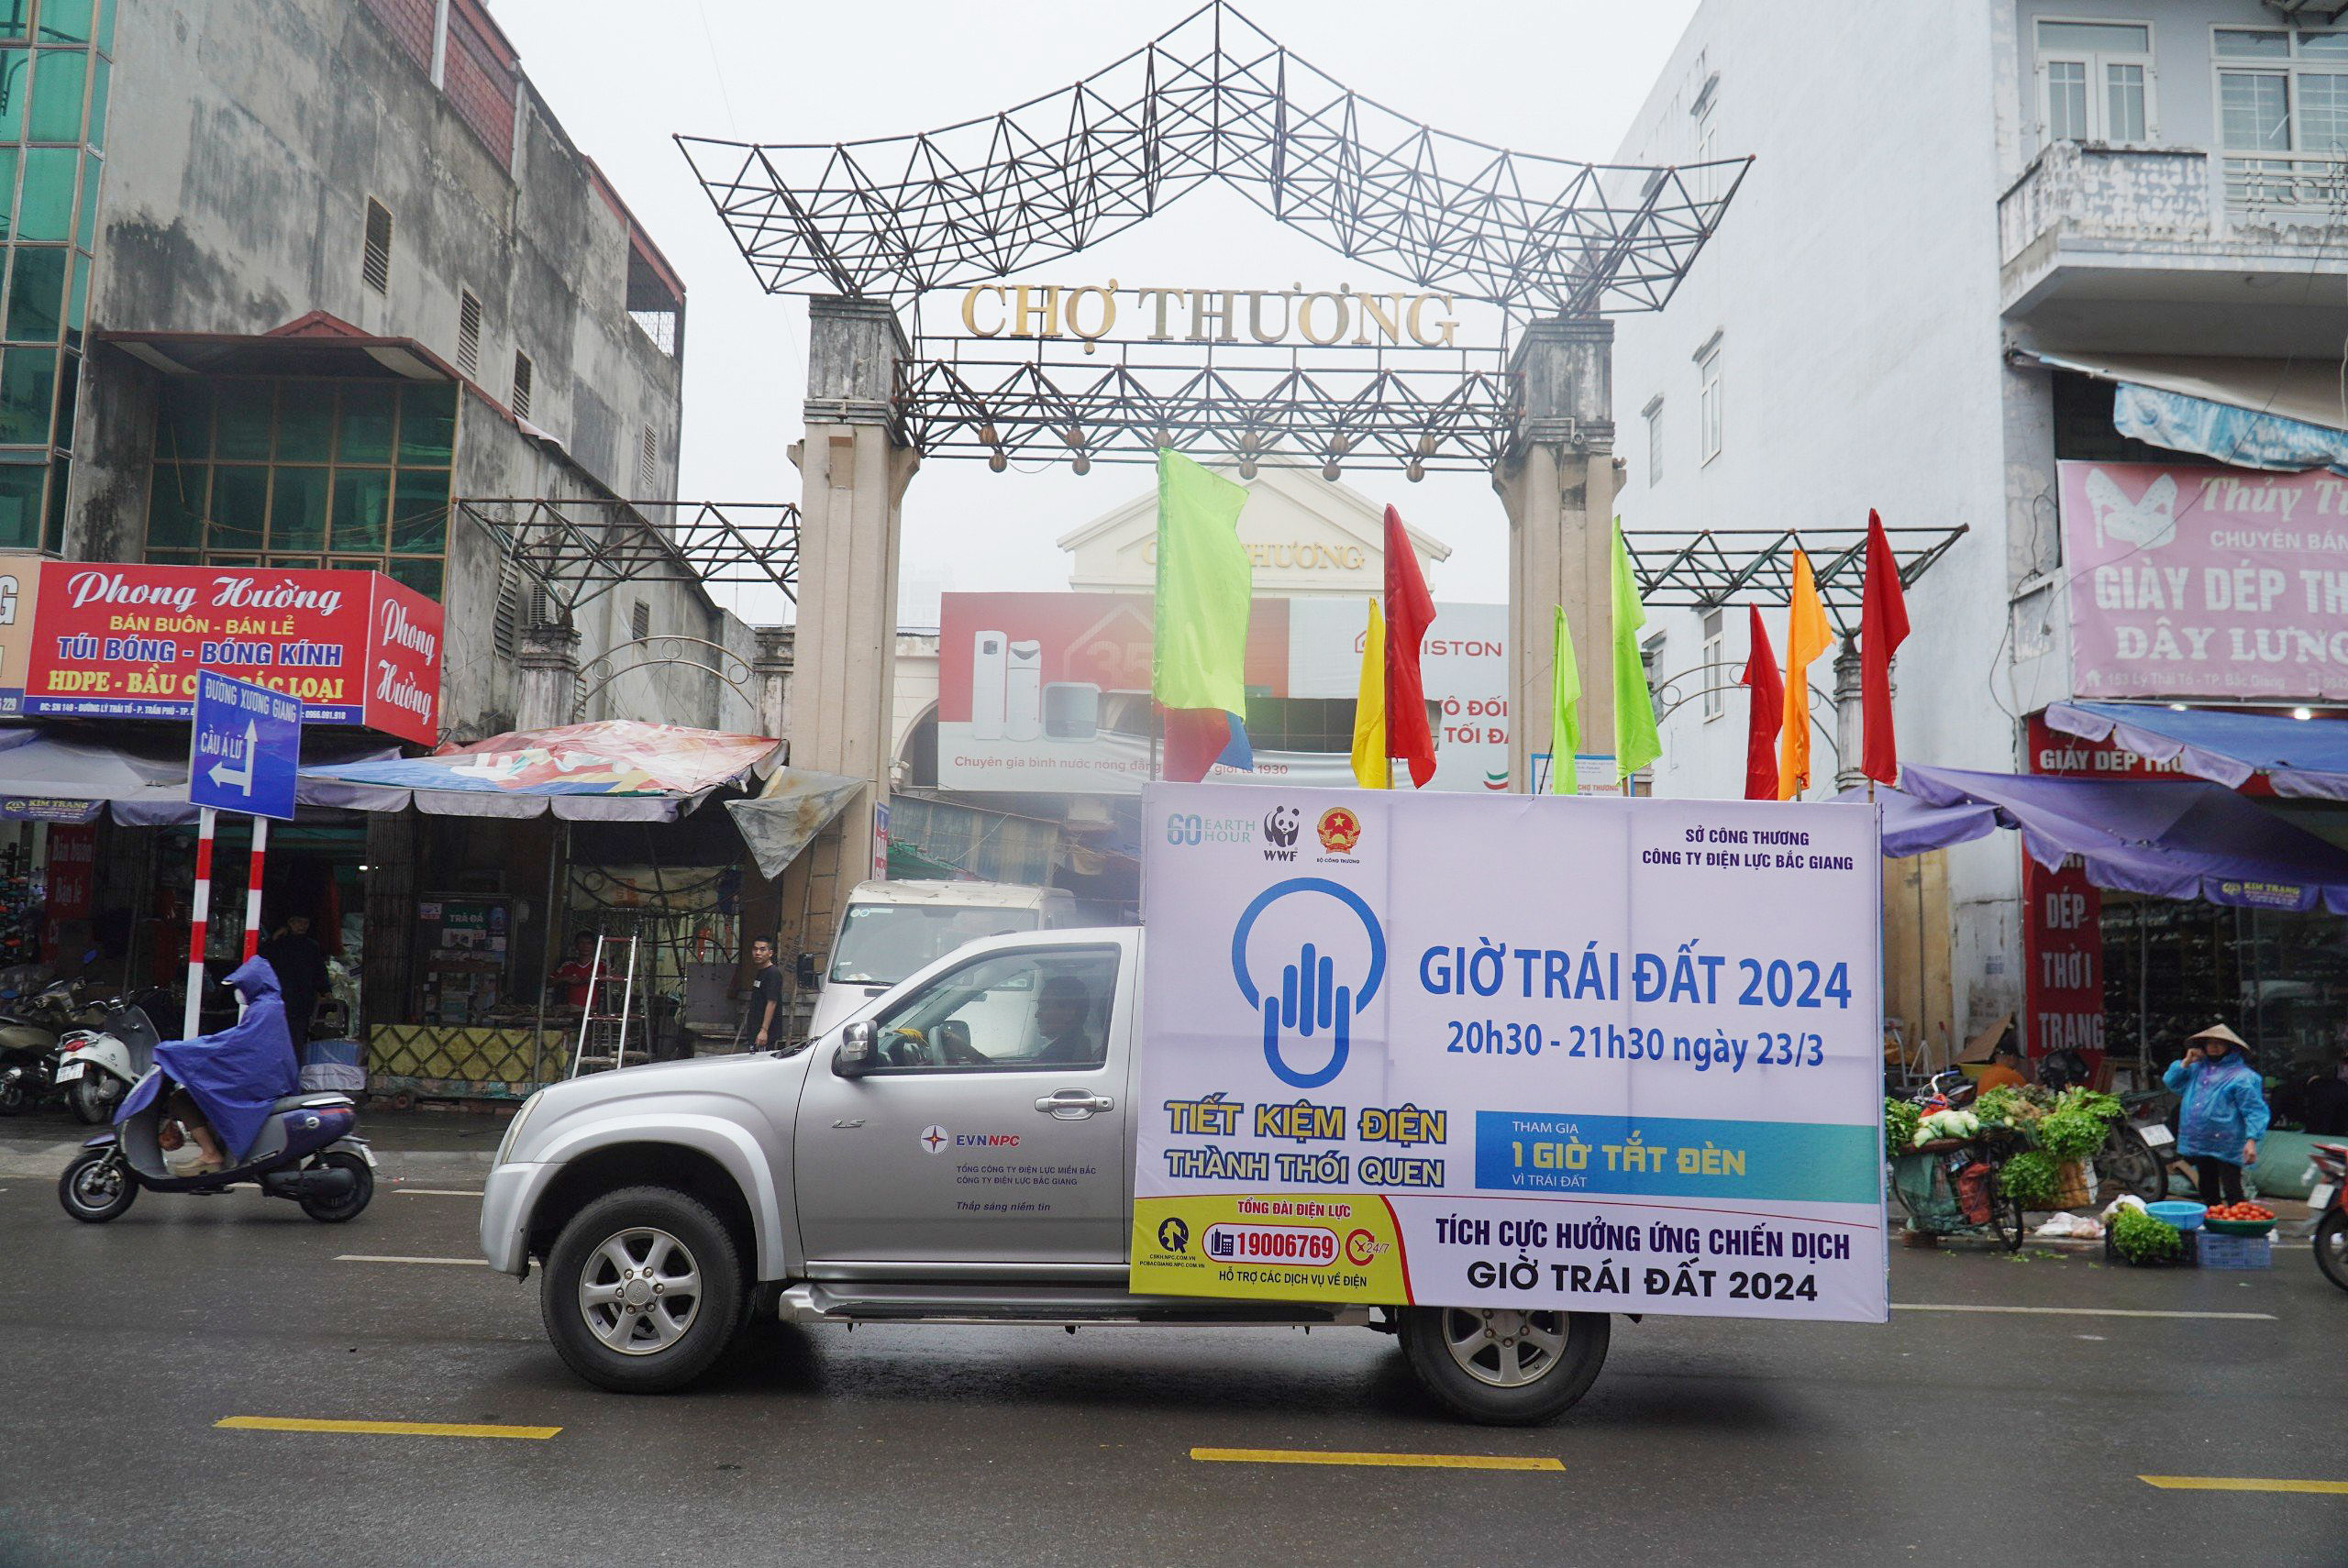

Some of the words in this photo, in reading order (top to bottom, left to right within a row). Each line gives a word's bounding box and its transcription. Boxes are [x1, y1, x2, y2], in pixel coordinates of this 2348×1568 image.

[961, 278, 1119, 355] CHỢ
[1138, 282, 1460, 348] THƯƠNG
[2210, 528, 2300, 549] CHUYÊN
[1243, 541, 1365, 569] HƯƠNG
[67, 571, 197, 613] Phong
[211, 577, 343, 617] Hường
[2095, 557, 2190, 612] GIÀY
[2204, 559, 2286, 613] DÉP
[110, 613, 150, 631] BÁN
[155, 614, 209, 633] BUÔN
[226, 616, 265, 635] BÁN
[271, 614, 294, 635] LẺ
[381, 598, 436, 662] Phong
[57, 633, 99, 660] TÚI
[104, 635, 176, 662] BÓNG
[200, 637, 272, 666] BÓNG
[279, 639, 343, 668] KÍNH
[1424, 641, 1502, 657] ISTON
[2115, 616, 2216, 661] DÂY
[2228, 625, 2348, 666] LƯNG
[48, 670, 110, 692] HDPE
[127, 663, 177, 694] BẦU
[289, 677, 344, 703] LOẠI
[377, 659, 432, 725] Hường
[205, 677, 237, 706] ĐƯỜNG
[239, 688, 270, 715] XƯƠNG
[272, 698, 296, 723] GIANG
[200, 724, 219, 755] CẦU
[1444, 722, 1480, 744] TỐI
[955, 756, 1002, 770] Chuyên
[1006, 757, 1024, 770] gia
[1028, 756, 1056, 768] bình
[1059, 756, 1091, 769] nước
[1257, 764, 1288, 775] 1930
[1167, 813, 1202, 846] 60
[1204, 819, 1256, 831] EARTH
[1204, 832, 1251, 845] HOUR
[1685, 824, 1705, 844] SỞ
[1709, 826, 1748, 845] CÔNG
[1753, 829, 1810, 846] THƯƠNG
[1264, 850, 1299, 862] WWF
[1643, 848, 1681, 866] CÔNG
[1685, 851, 1702, 867] TY
[1706, 850, 1740, 870] ĐIỆN
[1744, 853, 1772, 871] LỰC
[1777, 849, 1805, 869] BẮC
[1809, 854, 1854, 871] GIANG
[2044, 885, 2086, 929] DÉP
[1419, 936, 1507, 997] GIỜ
[1513, 940, 1619, 1001] TRÁI
[1632, 938, 1725, 1005] ĐẤT
[1738, 958, 1853, 1010] 2024
[2042, 943, 2092, 989] THỜI
[1446, 1020, 1543, 1055] 20h30
[1568, 1024, 1665, 1061] 21h30
[1673, 1029, 1748, 1073] ngày
[1756, 1032, 1824, 1067] 23/3
[2038, 1011, 2105, 1050] TRANG
[1164, 1092, 1244, 1136] TIẾT
[1254, 1099, 1346, 1143] KIỆM
[1357, 1102, 1447, 1148] ĐIỆN
[1512, 1121, 1553, 1133] THAM
[1555, 1122, 1578, 1134] GIA
[1164, 1145, 1269, 1182] THÀNH
[1275, 1150, 1349, 1185] THÓI
[1357, 1155, 1445, 1188] QUEN
[1512, 1142, 1523, 1168] 1
[1533, 1136, 1591, 1170] GIỜ
[1602, 1130, 1667, 1173] TẮT
[1676, 1141, 1745, 1176] ĐÈN
[956, 1176, 980, 1185] CÔNG
[981, 1176, 991, 1185] TY
[1051, 1177, 1078, 1186] GIANG
[980, 1165, 1004, 1174] CÔNG
[1007, 1165, 1017, 1174] TY
[1018, 1165, 1037, 1176] ĐIỆN
[1512, 1173, 1526, 1186] VÌ
[1528, 1173, 1557, 1187] TRÁI
[1559, 1173, 1588, 1187] ĐẤT
[983, 1202, 1007, 1213] sáng
[1037, 1202, 1051, 1211] tin
[1237, 1197, 1269, 1215] TỔNG
[1272, 1200, 1293, 1216] ĐÀI
[1295, 1201, 1325, 1219] ĐIỆN
[1328, 1203, 1351, 1220] LỰC
[1237, 1231, 1333, 1259] 19006769
[1435, 1213, 1490, 1245] TÍCH
[1499, 1220, 1547, 1253] CỰC
[1556, 1216, 1641, 1252] HƯỞNG
[1649, 1221, 1700, 1253] ỨNG
[1709, 1222, 1784, 1257] CHIẾN
[1792, 1232, 1850, 1264] DỊCH
[1219, 1265, 1235, 1281] HỖ
[1236, 1270, 1257, 1286] TRỢ
[1259, 1269, 1281, 1284] CÁC
[1284, 1272, 1309, 1287] DỊCH
[1311, 1274, 1325, 1287] VỤ
[1326, 1272, 1341, 1286] VỀ
[1343, 1273, 1368, 1289] ĐIỆN
[1468, 1255, 1540, 1291] GIỜ
[1551, 1259, 1630, 1296] TRÁI
[1643, 1257, 1717, 1298] ĐẤT
[1729, 1271, 1818, 1302] 2024
